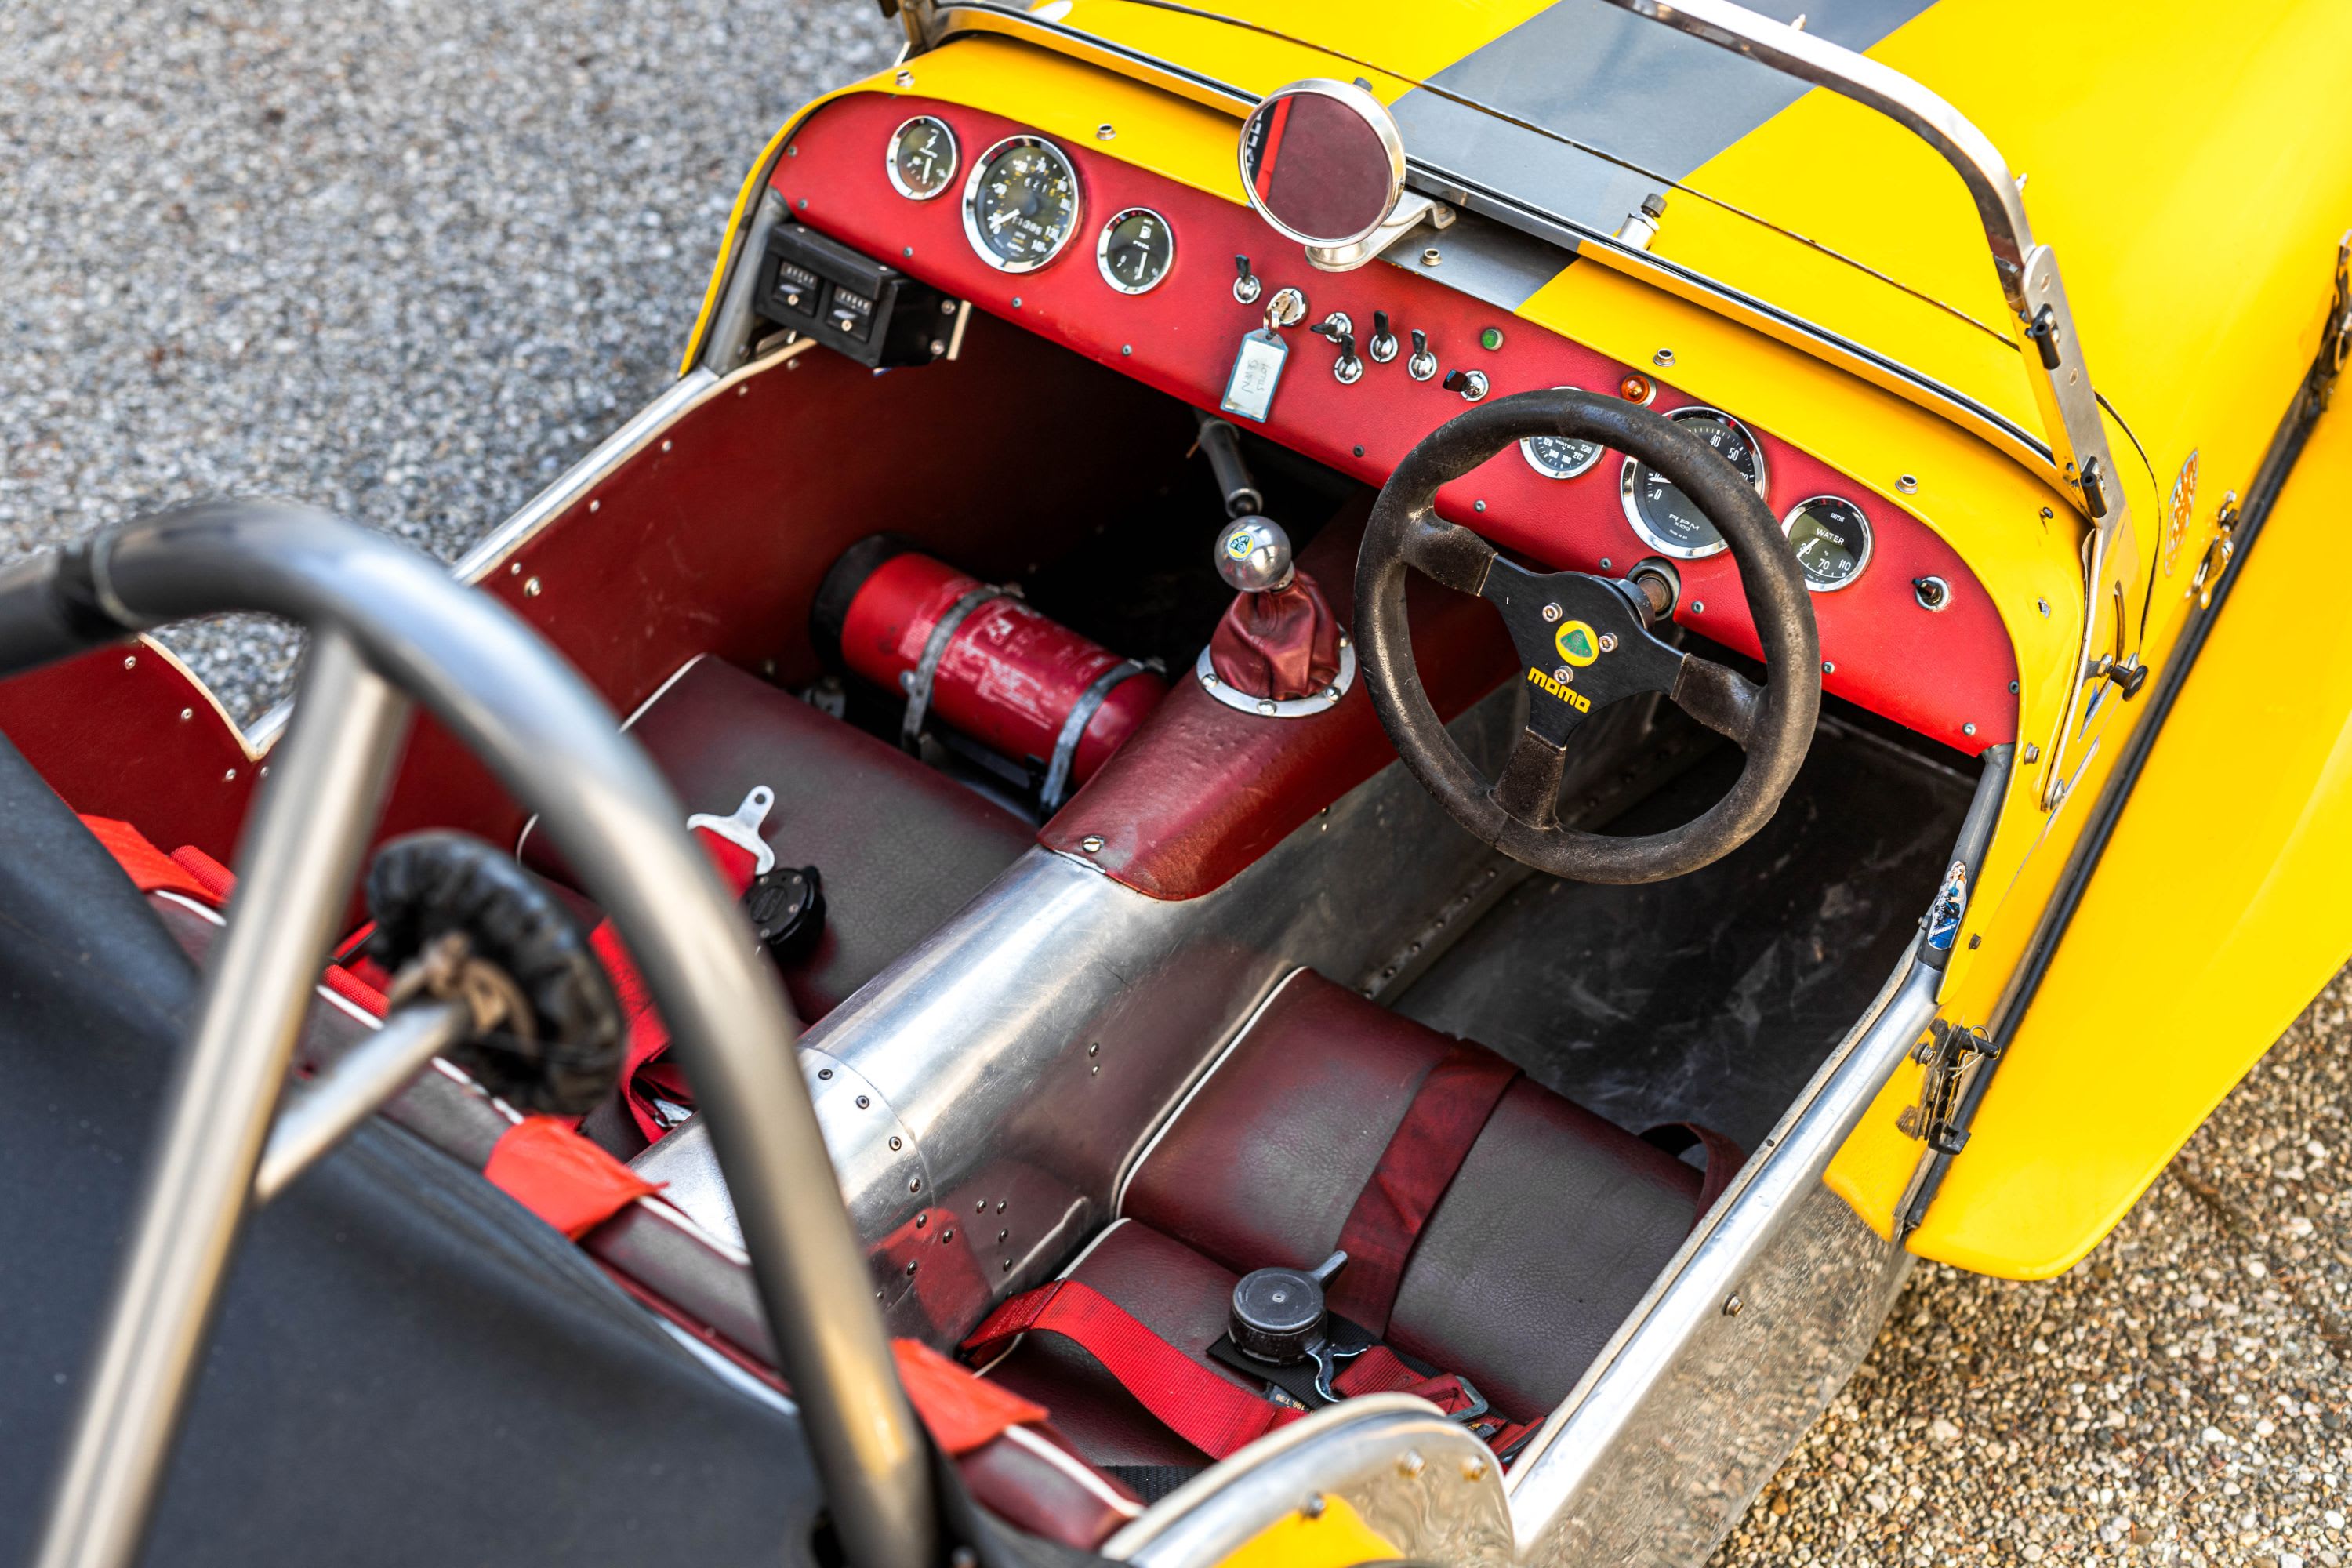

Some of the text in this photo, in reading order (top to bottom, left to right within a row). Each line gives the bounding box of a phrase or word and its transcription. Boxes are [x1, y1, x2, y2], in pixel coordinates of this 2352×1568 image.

[1133, 240, 1151, 251] FUEL
[1555, 438, 1576, 451] WATER
[1709, 435, 1721, 448] 40
[1580, 443, 1592, 454] 230
[1727, 447, 1740, 461] 50
[1572, 451, 1584, 462] 212
[1653, 488, 1663, 500] 0
[1830, 512, 1846, 523] SMITHS
[1816, 528, 1845, 546] WATER
[1818, 557, 1831, 571] 70
[1838, 559, 1852, 572] 110
